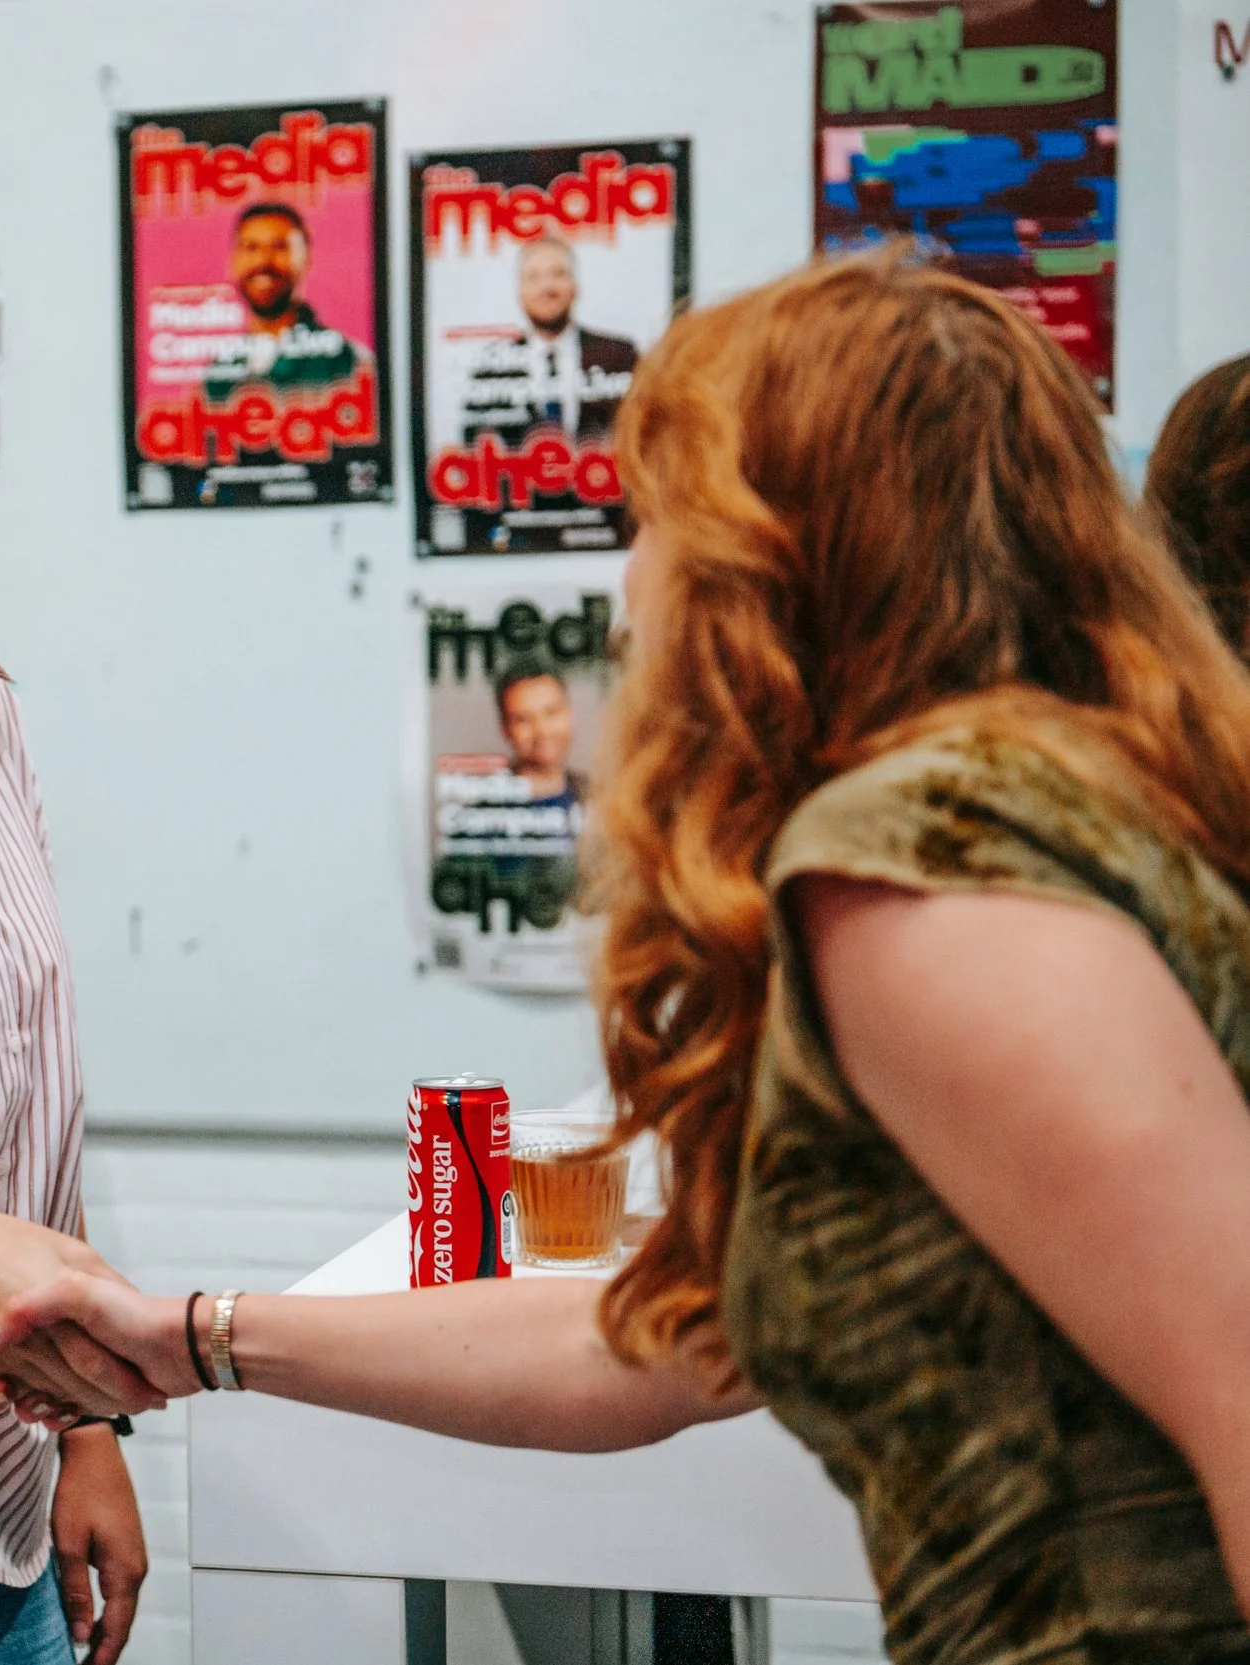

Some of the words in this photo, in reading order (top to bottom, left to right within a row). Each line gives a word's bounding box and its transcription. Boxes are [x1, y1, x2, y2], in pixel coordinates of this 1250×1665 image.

[132, 111, 374, 203] media
[426, 152, 674, 246] media
[137, 364, 379, 464] ahead
[429, 430, 624, 509] ahea
[429, 594, 612, 680] medi
[430, 856, 566, 933] ahe
[433, 1135, 458, 1215] sugar
[433, 1219, 453, 1284] zero
